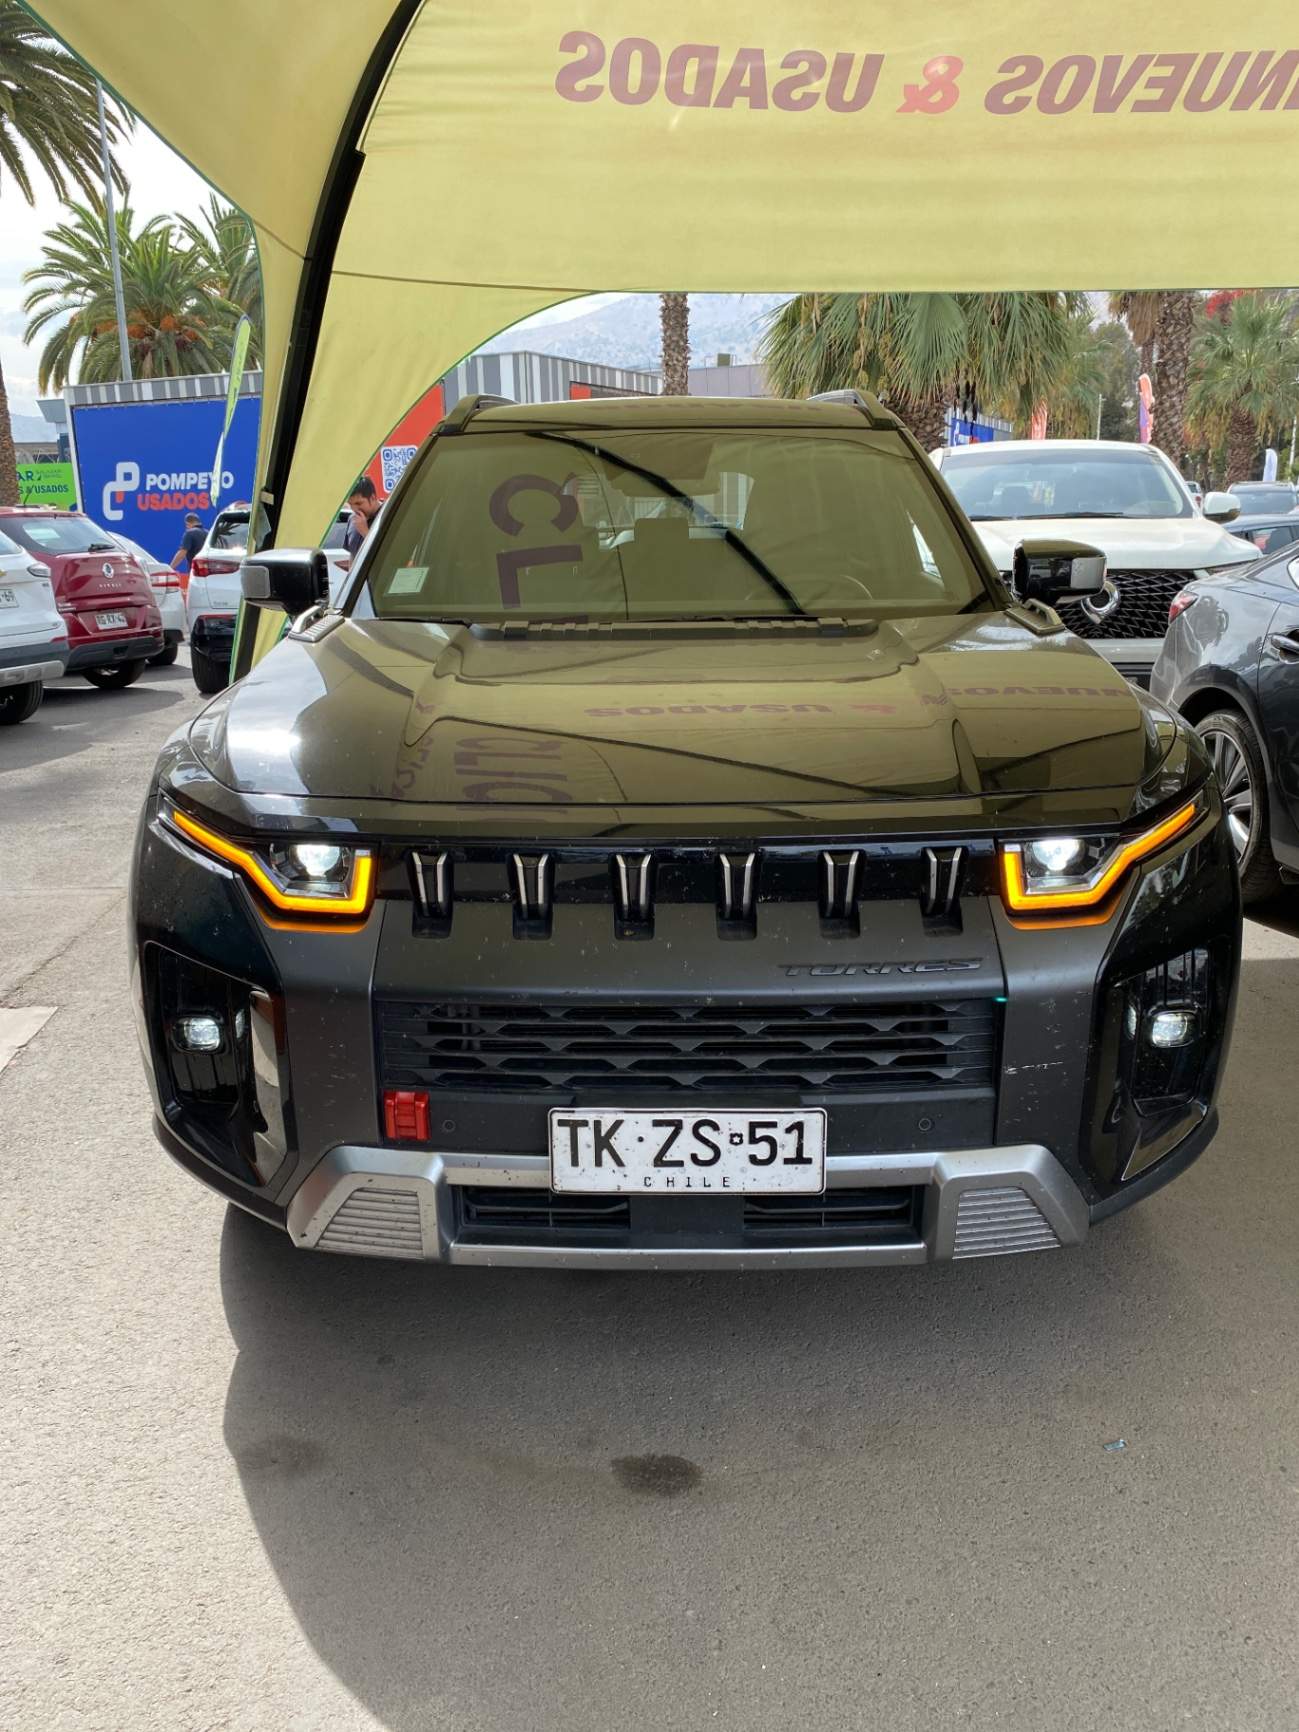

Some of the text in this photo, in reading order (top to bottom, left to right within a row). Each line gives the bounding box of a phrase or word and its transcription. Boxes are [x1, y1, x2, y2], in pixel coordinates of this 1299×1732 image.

[34, 484, 69, 494] USADOS
[137, 492, 209, 511] USADOS
[778, 957, 984, 977] TORRES
[643, 1176, 730, 1188] CHILE
